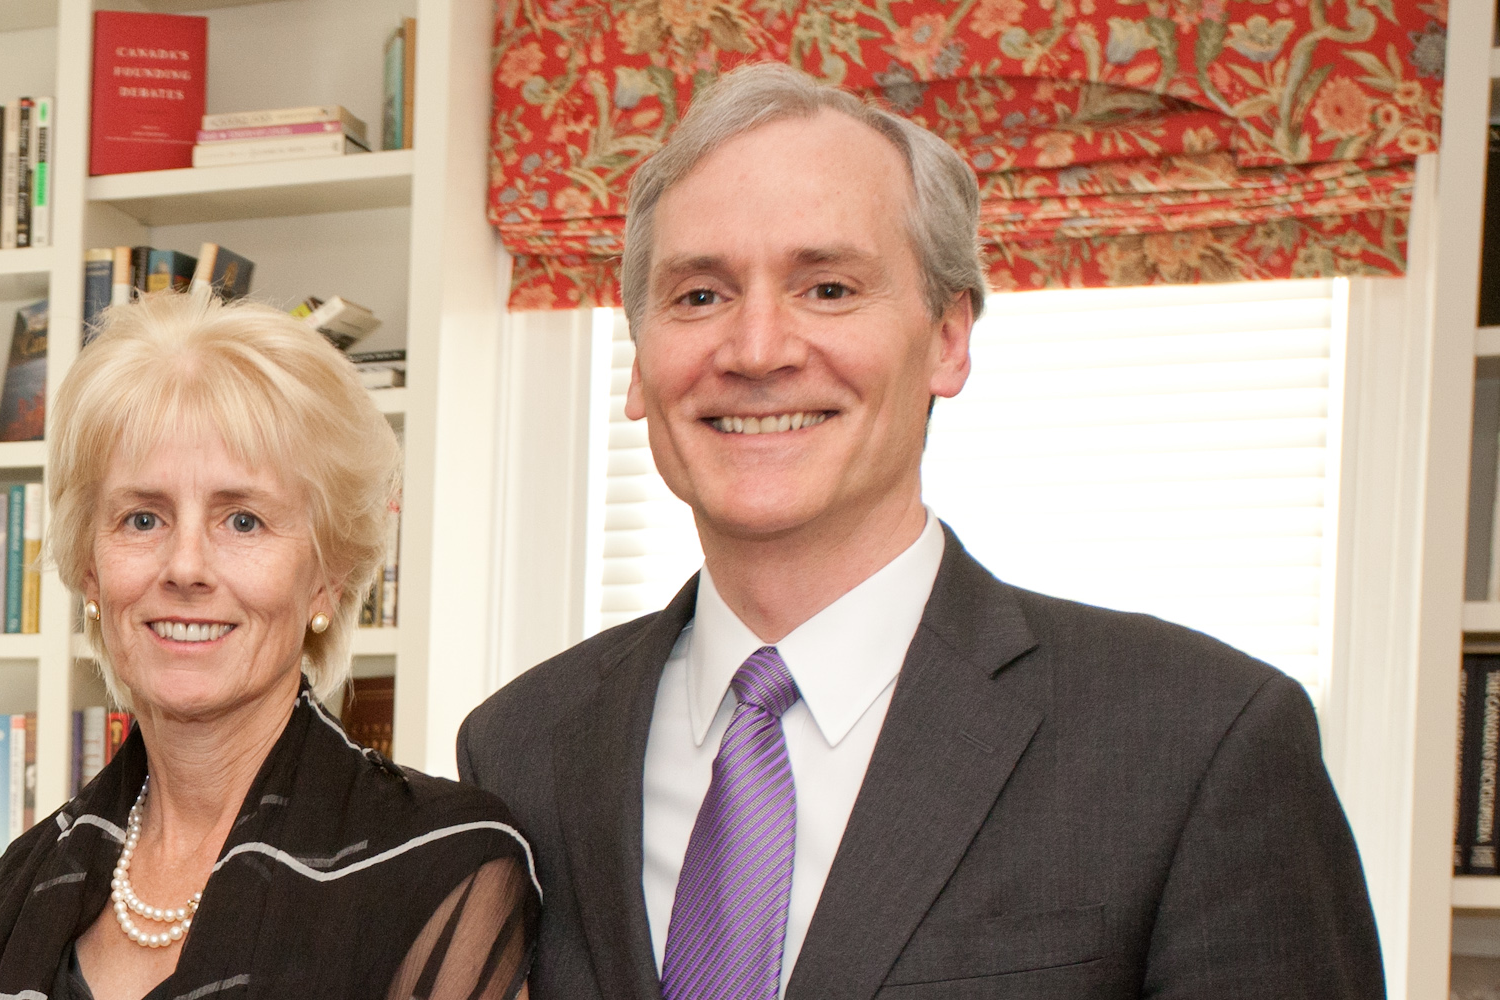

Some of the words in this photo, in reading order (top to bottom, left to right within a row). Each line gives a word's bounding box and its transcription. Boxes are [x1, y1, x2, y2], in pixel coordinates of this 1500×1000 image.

[115, 47, 190, 60] CANADA'S
[112, 66, 192, 80] FOUNDING
[118, 86, 185, 100] DEBATES
[1484, 670, 1500, 696] THE
[1481, 695, 1500, 760] CANADIAN
[1476, 760, 1497, 843] ENCYCLOPEDIA
